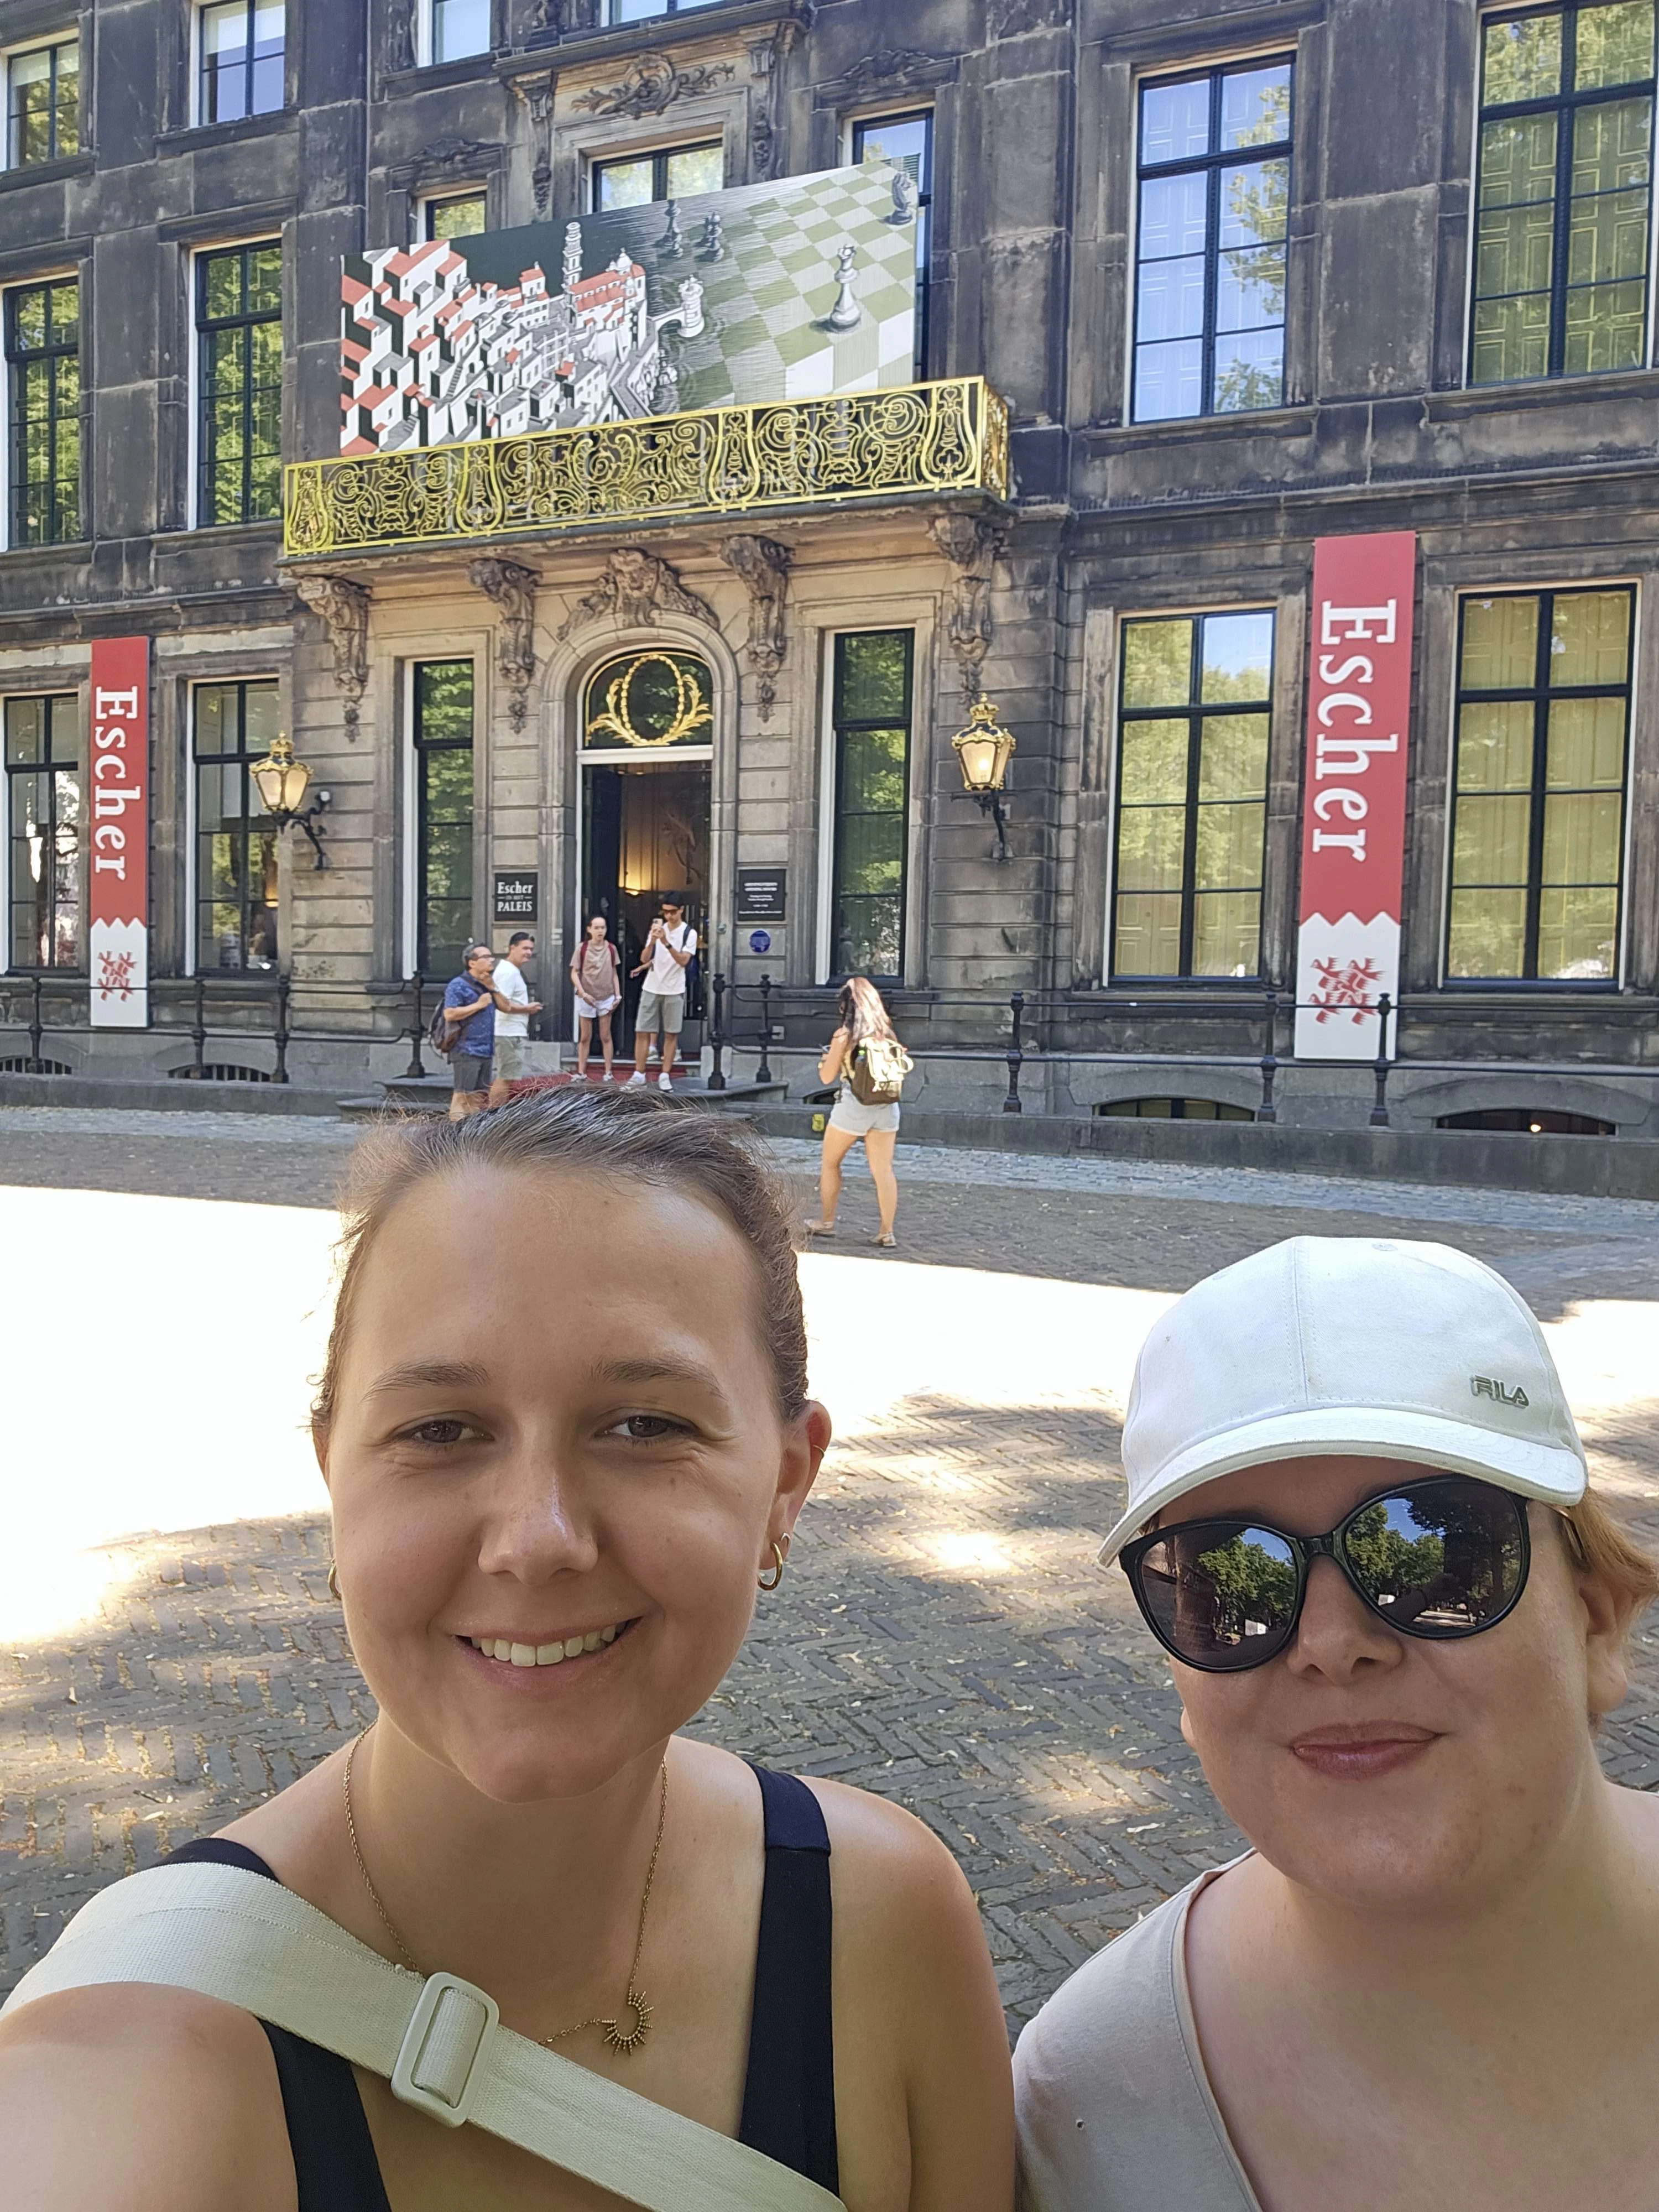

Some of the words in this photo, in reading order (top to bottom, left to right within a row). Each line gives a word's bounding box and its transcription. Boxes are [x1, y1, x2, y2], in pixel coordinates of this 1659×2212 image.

[1313, 599, 1399, 862] Escher
[95, 686, 140, 880] Escher
[497, 881, 533, 894] Escher
[497, 901, 533, 911] PALEIS
[1470, 1375, 1529, 1408] FILA
